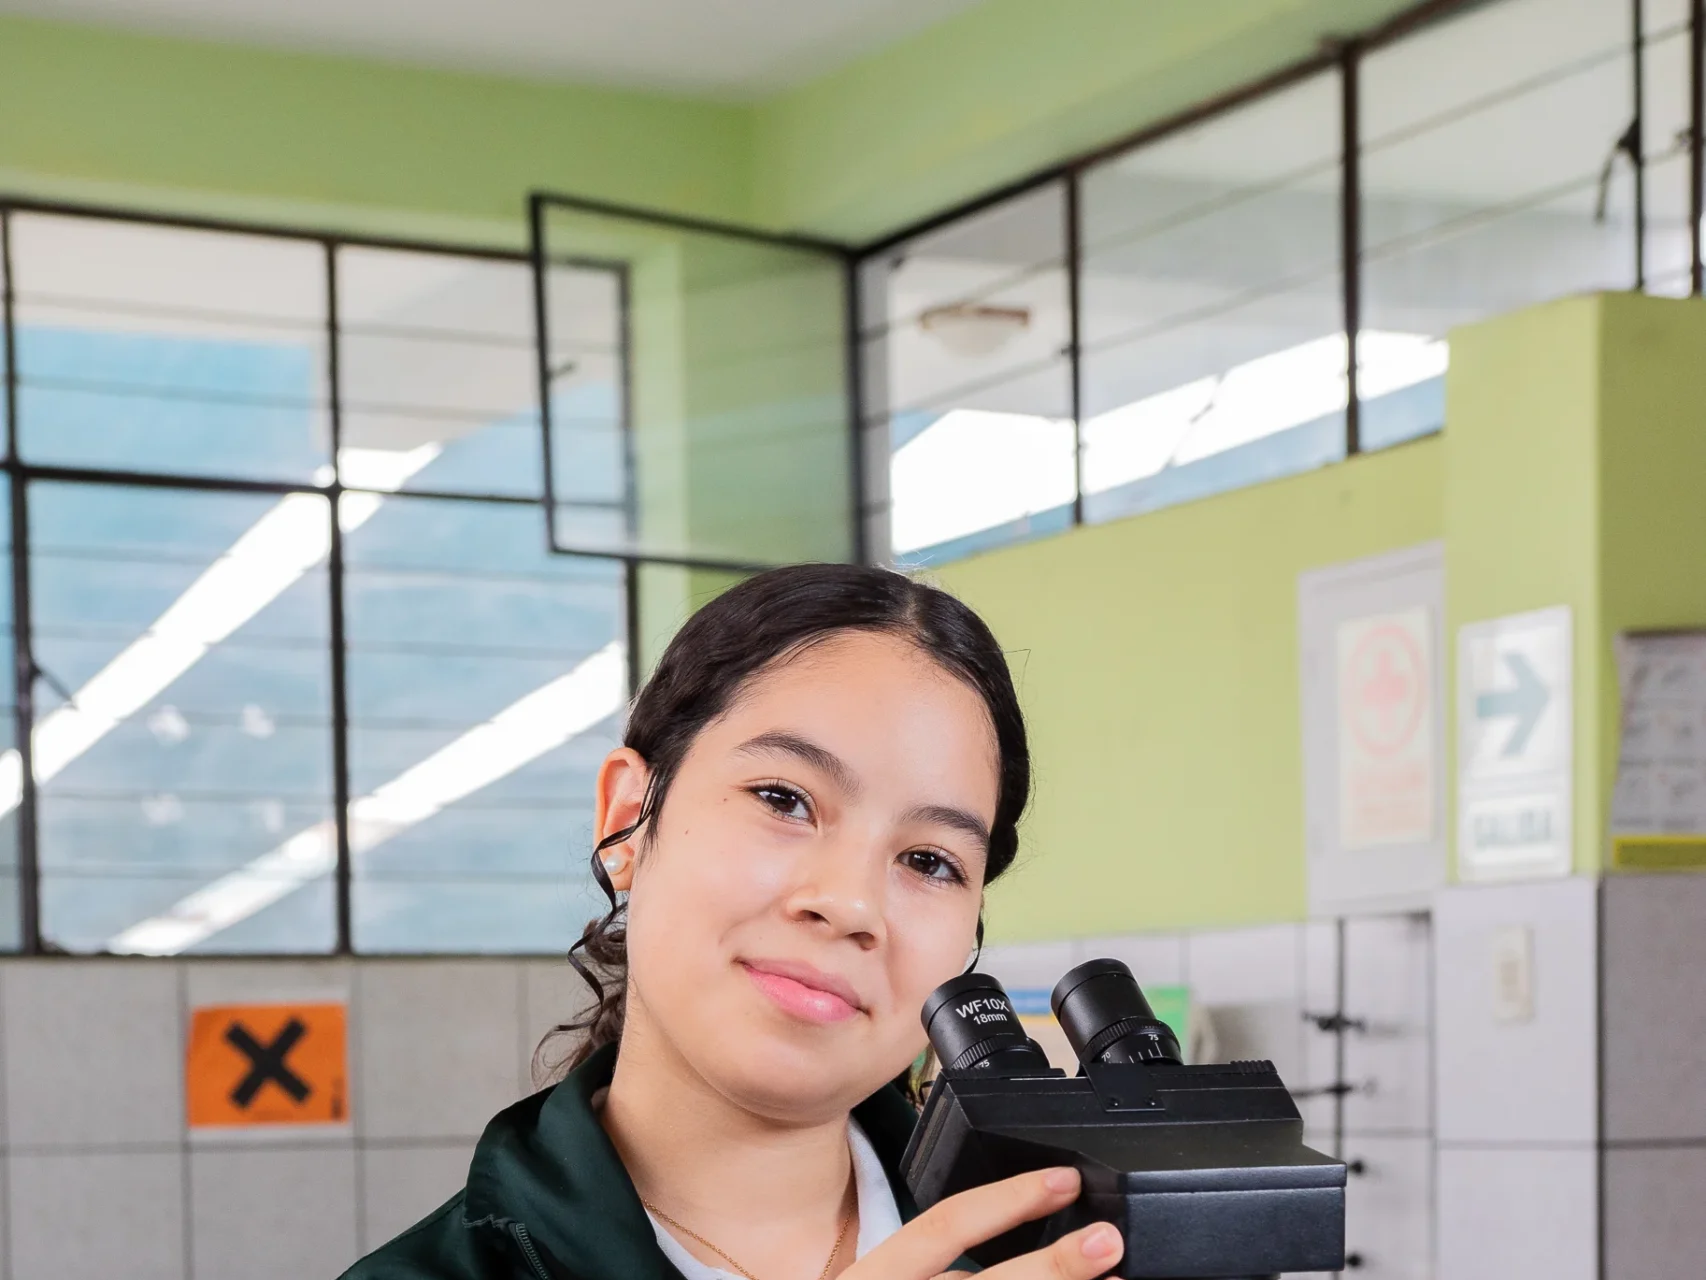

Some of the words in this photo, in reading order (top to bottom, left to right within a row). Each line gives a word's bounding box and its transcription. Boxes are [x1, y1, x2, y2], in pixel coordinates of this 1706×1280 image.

[956, 998, 1010, 1019] WF10X
[973, 1013, 1008, 1025] 18mm
[1101, 1051, 1112, 1063] 70
